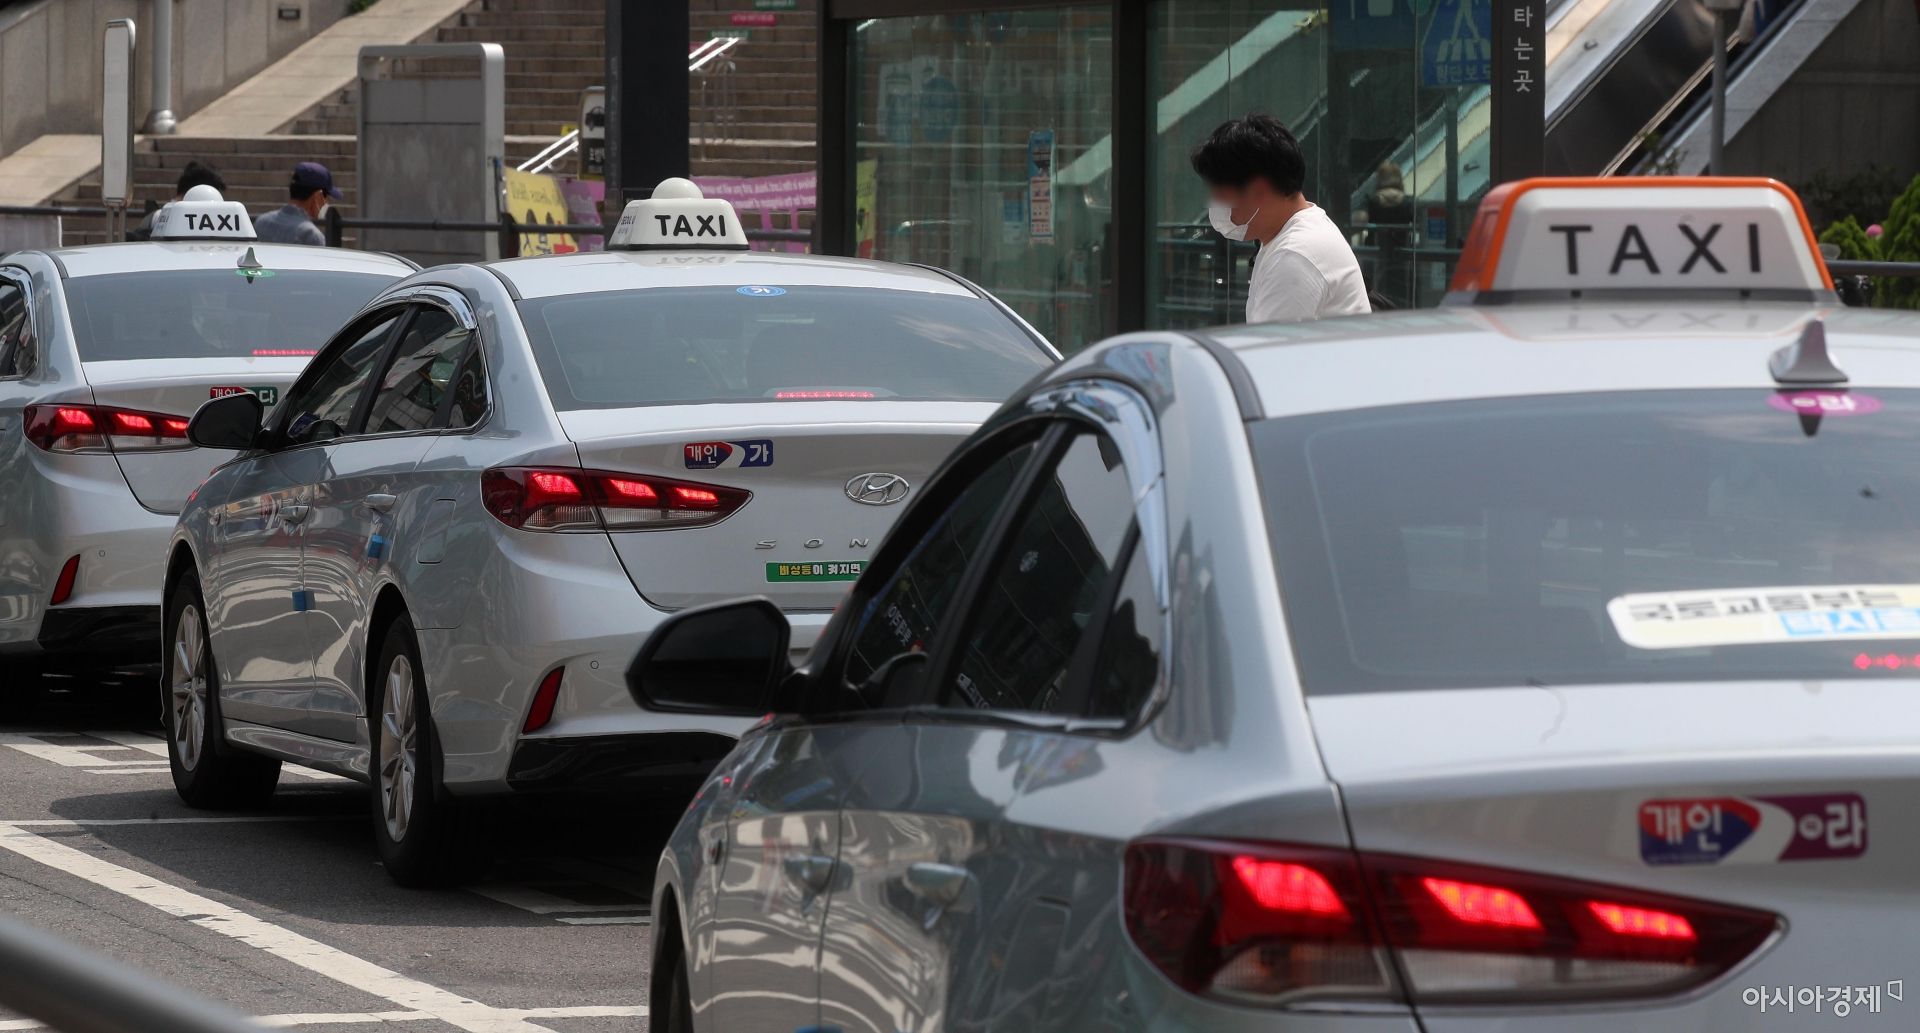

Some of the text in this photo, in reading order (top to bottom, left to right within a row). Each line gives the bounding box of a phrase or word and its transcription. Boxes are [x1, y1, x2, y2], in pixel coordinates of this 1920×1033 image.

[185, 213, 240, 231] TAXI
[655, 214, 726, 237] TAXI
[1549, 223, 1761, 275] TAXI
[259, 389, 275, 404] 다
[686, 443, 769, 464] 개인 가
[779, 564, 823, 577] 비상등이
[1644, 803, 1722, 852] 개인
